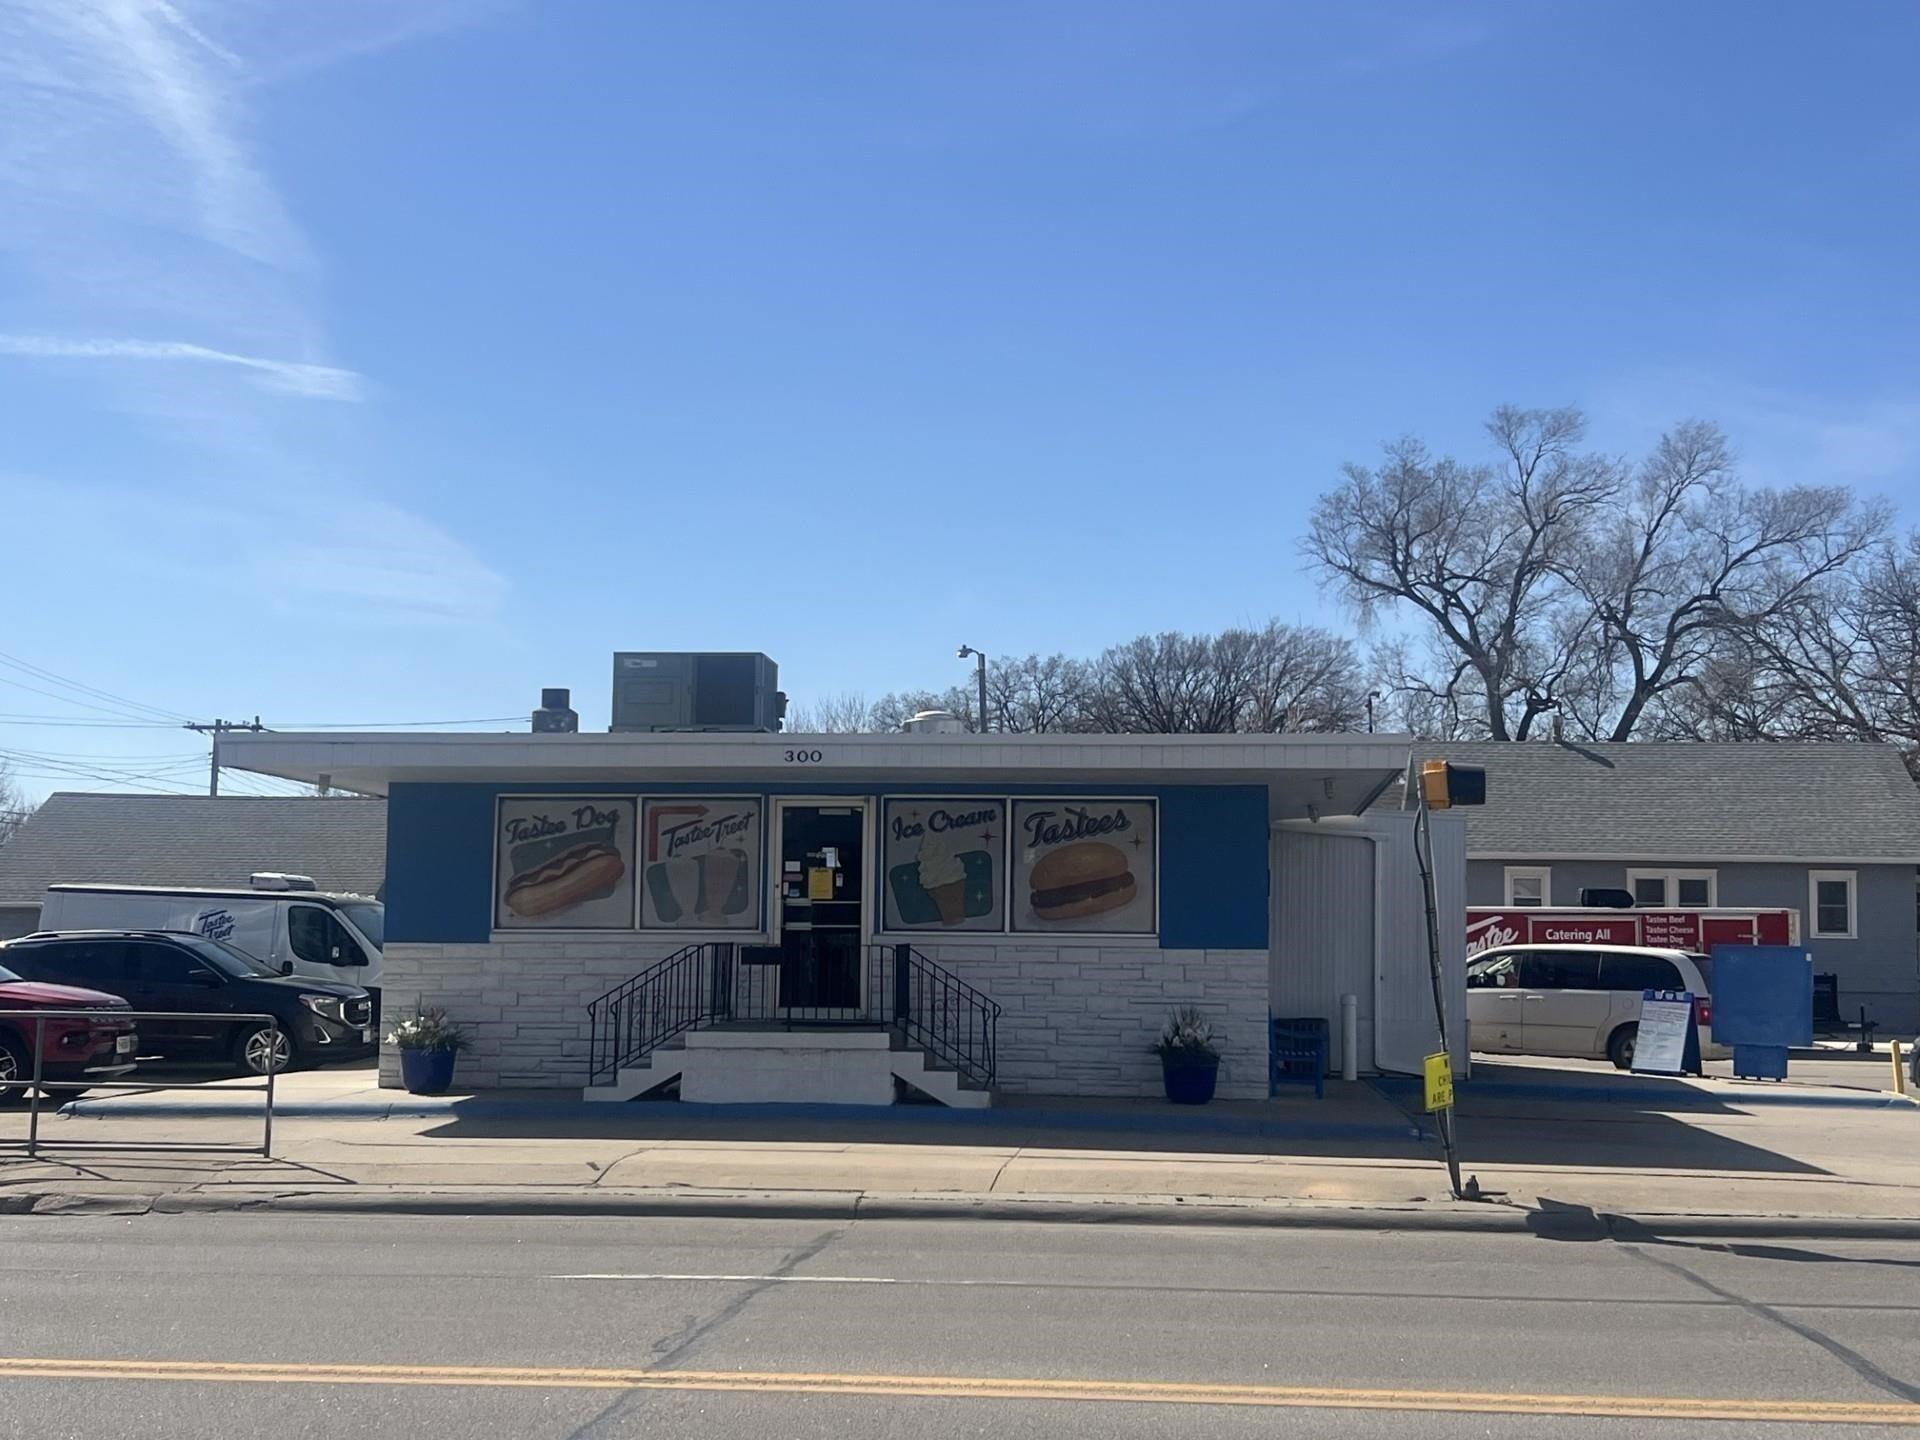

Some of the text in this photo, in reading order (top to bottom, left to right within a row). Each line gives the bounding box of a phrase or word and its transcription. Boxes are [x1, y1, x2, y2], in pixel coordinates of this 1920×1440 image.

[784, 750, 823, 763] 300
[505, 805, 620, 844] Tastee Dog
[892, 808, 996, 841] Ice Cream
[1023, 807, 1132, 848] Tastees
[661, 811, 756, 857] Tastee Treet
[198, 910, 235, 934] Tastee
[1645, 915, 1685, 923] Tastee Beef
[1545, 928, 1611, 943] Catering All
[1645, 926, 1694, 934] Tastee Cheese
[1645, 935, 1684, 944] Tastee Dog
[1432, 1090, 1446, 1105] ARE
